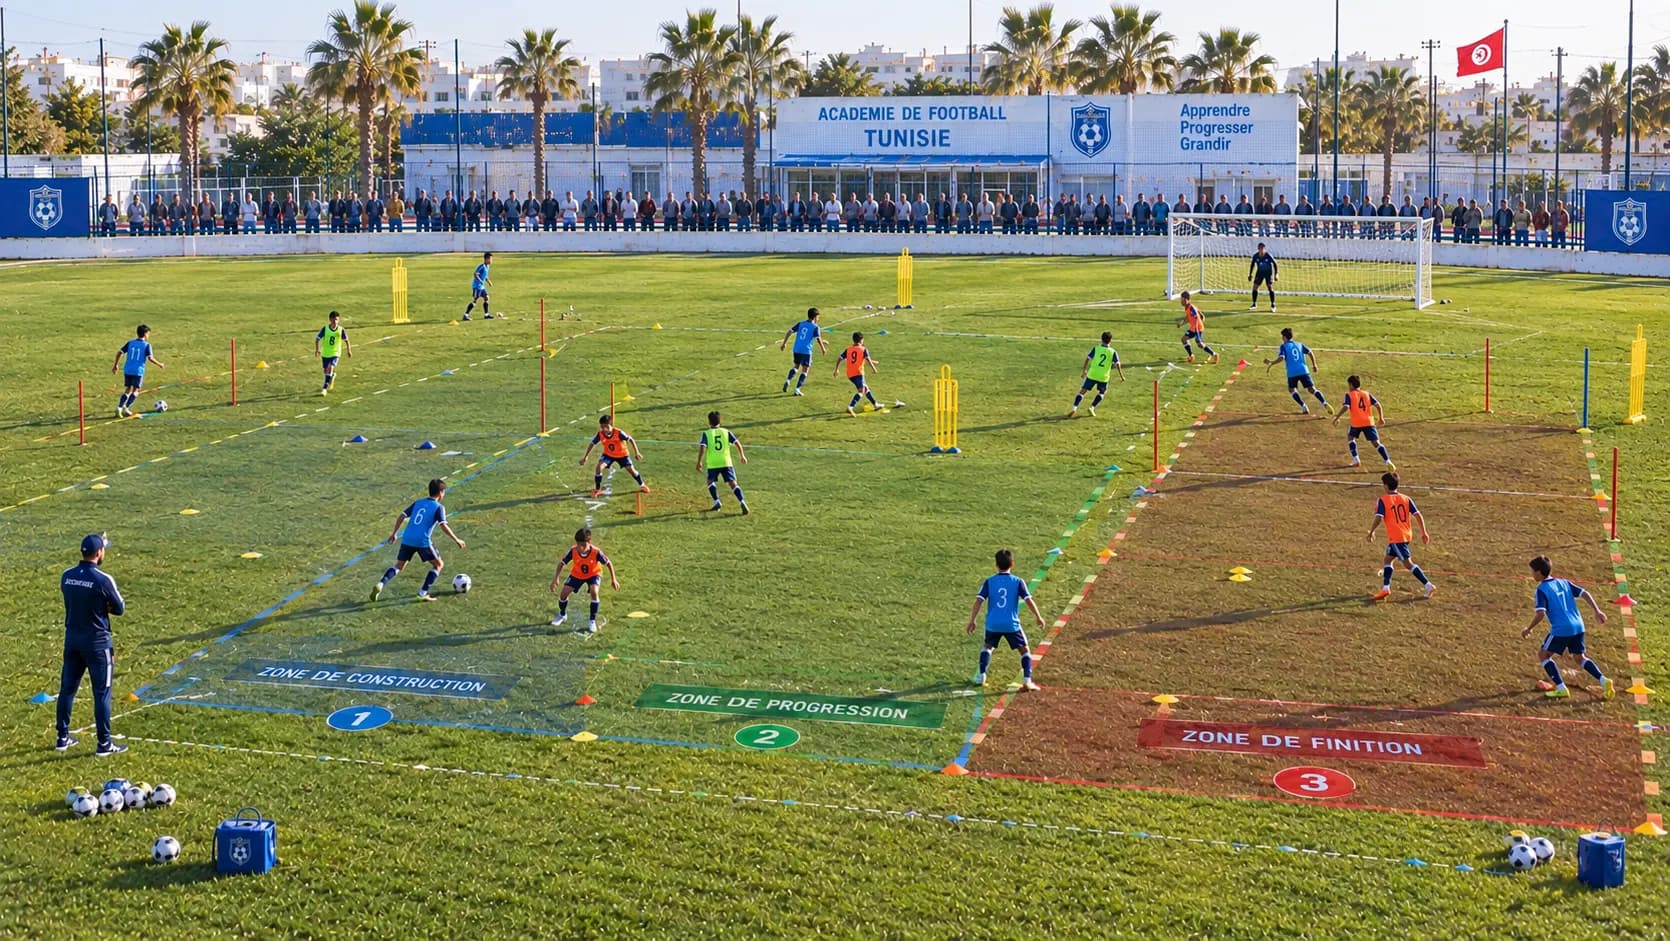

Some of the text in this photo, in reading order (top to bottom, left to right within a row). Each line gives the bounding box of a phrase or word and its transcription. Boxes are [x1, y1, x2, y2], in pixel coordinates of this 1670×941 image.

[818, 105, 1007, 121] ACADEMIE DE FOOTBALL
[1180, 103, 1250, 120] Apprendre
[1180, 121, 1254, 137] Progresser
[864, 129, 951, 147] TUNISIE
[1180, 137, 1232, 150] Grandir
[800, 328, 808, 340] 9
[131, 347, 140, 360] 11
[851, 351, 858, 363] 9
[1098, 354, 1107, 367] 2
[1291, 348, 1299, 361] 9
[1358, 398, 1366, 412] 4
[714, 435, 722, 451] 5
[413, 508, 426, 526] 6
[1391, 503, 1407, 524] 10
[996, 587, 1007, 608] 3
[1556, 590, 1568, 612] 7
[257, 667, 487, 693] ZONE DE CONSTRUCTION
[666, 693, 909, 720] ZONE DE PROGRESSION
[351, 711, 371, 726] 1
[753, 729, 780, 744] 2
[1182, 729, 1423, 755] ZONE DE FINITION
[1300, 773, 1329, 791] 3
